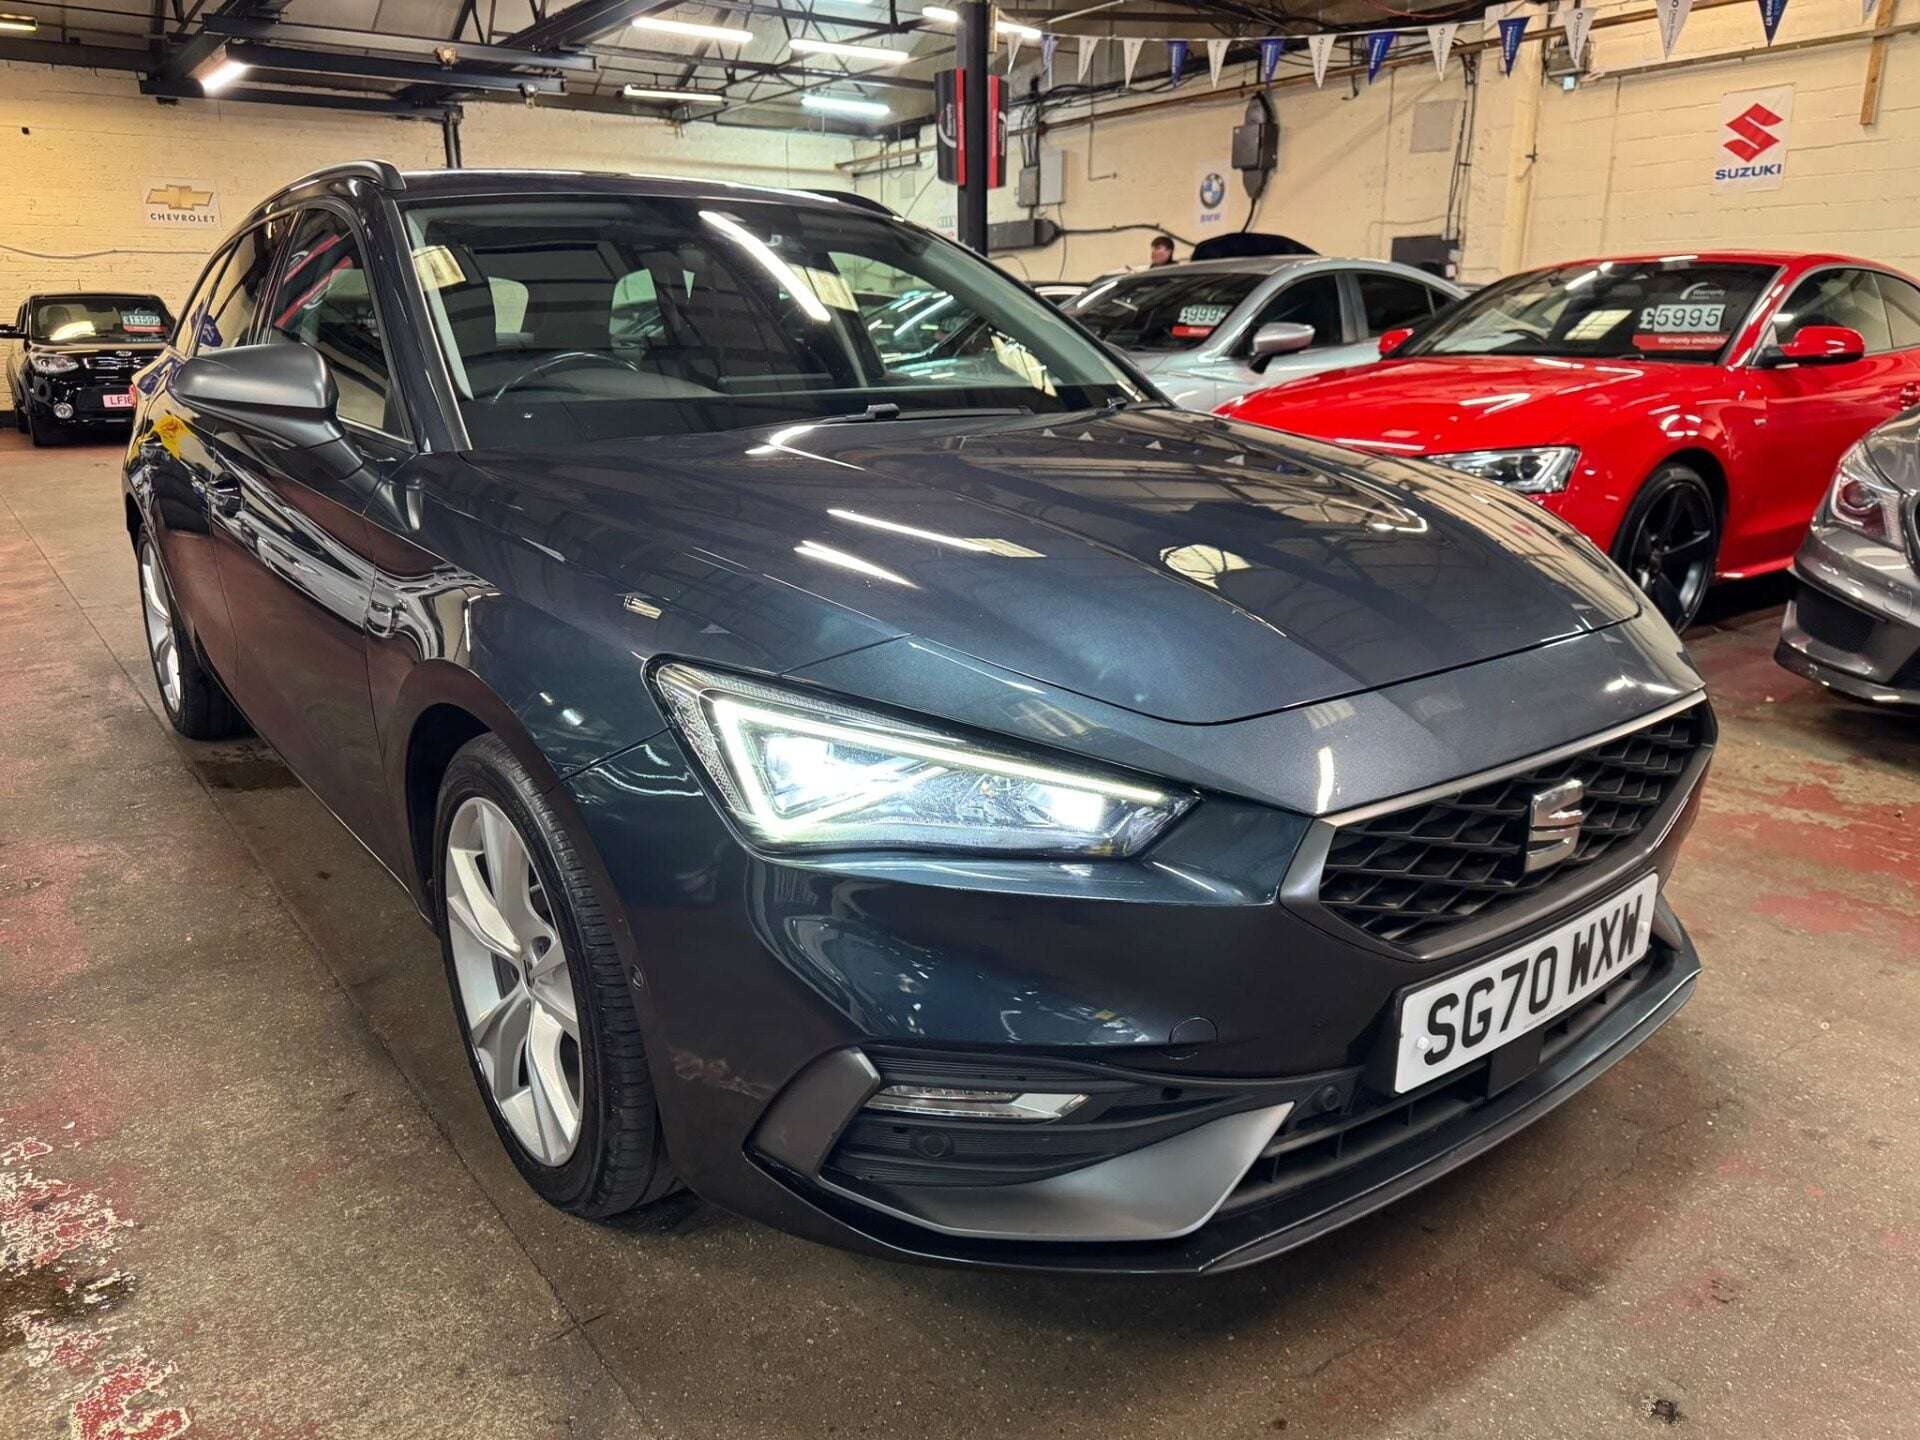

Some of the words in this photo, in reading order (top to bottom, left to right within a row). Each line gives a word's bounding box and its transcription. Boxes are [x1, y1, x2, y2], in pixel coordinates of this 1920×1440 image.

[1715, 163, 1782, 180] SUZUKI
[150, 213, 216, 222] CHEVROLET
[1639, 308, 1721, 329] £5995
[1424, 946, 1558, 1066] SG70
[1568, 894, 1643, 996] WXW
